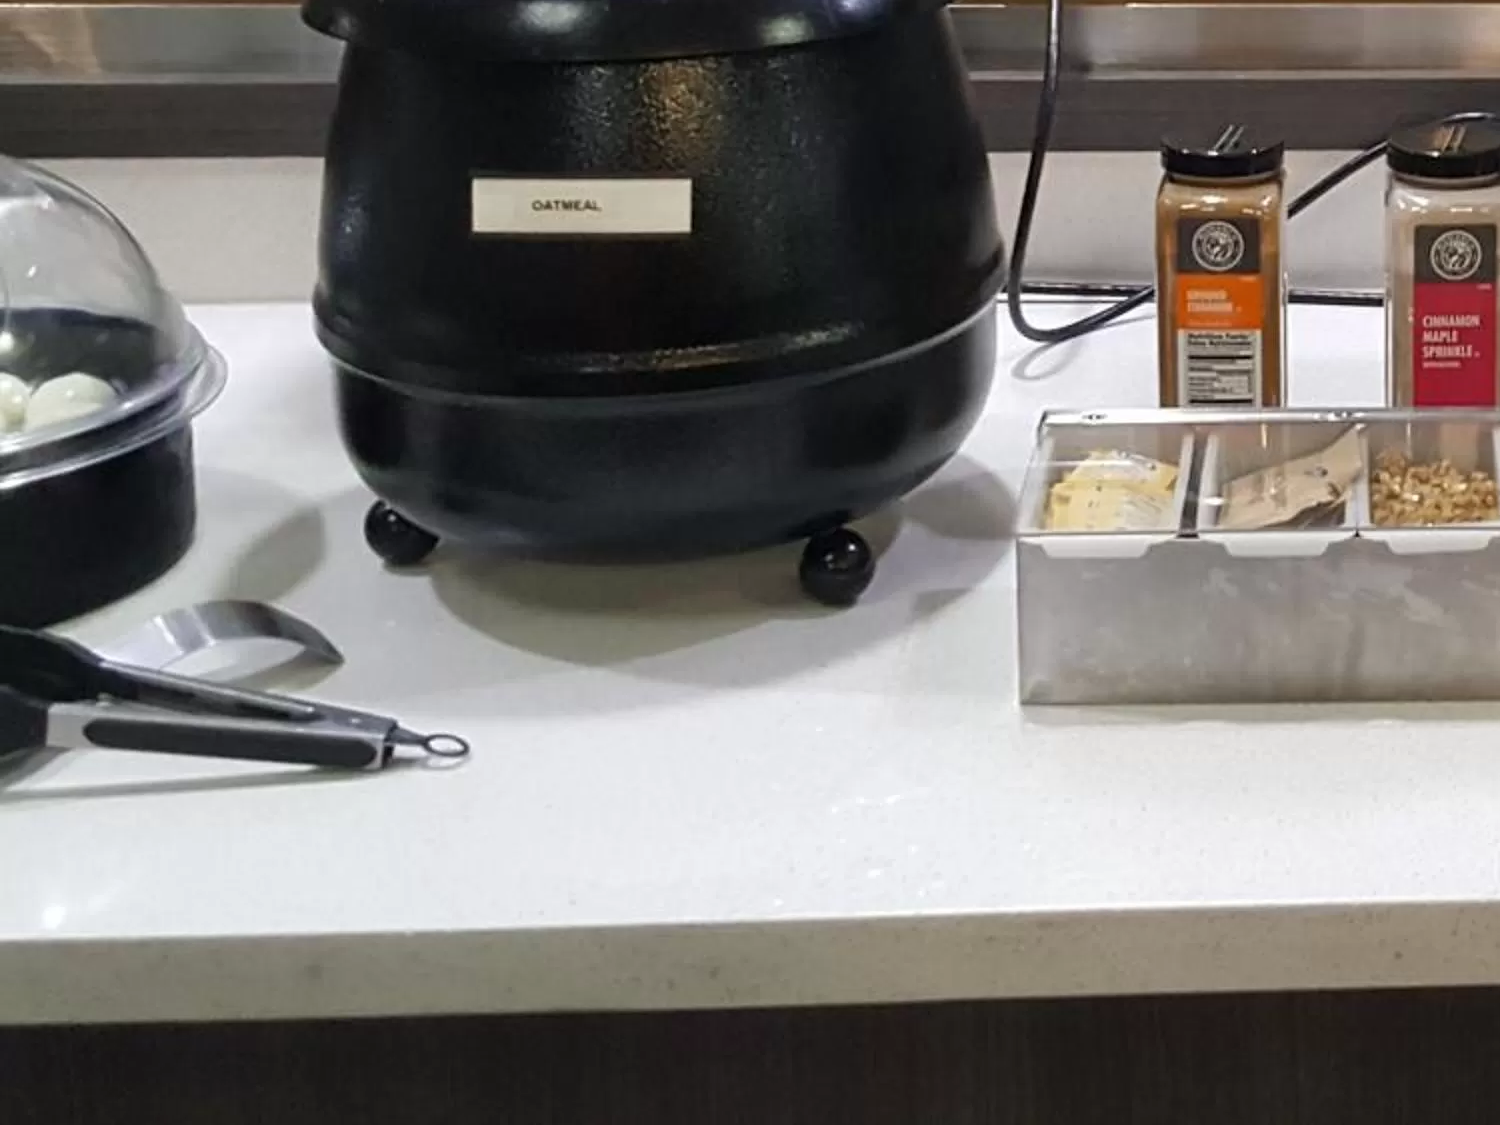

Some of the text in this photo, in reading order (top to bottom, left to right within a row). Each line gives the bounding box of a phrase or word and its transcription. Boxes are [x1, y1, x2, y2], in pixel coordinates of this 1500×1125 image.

[531, 199, 603, 212] OATMEAL
[1422, 314, 1481, 328] CINNAMON
[1422, 330, 1459, 343] MAPLE
